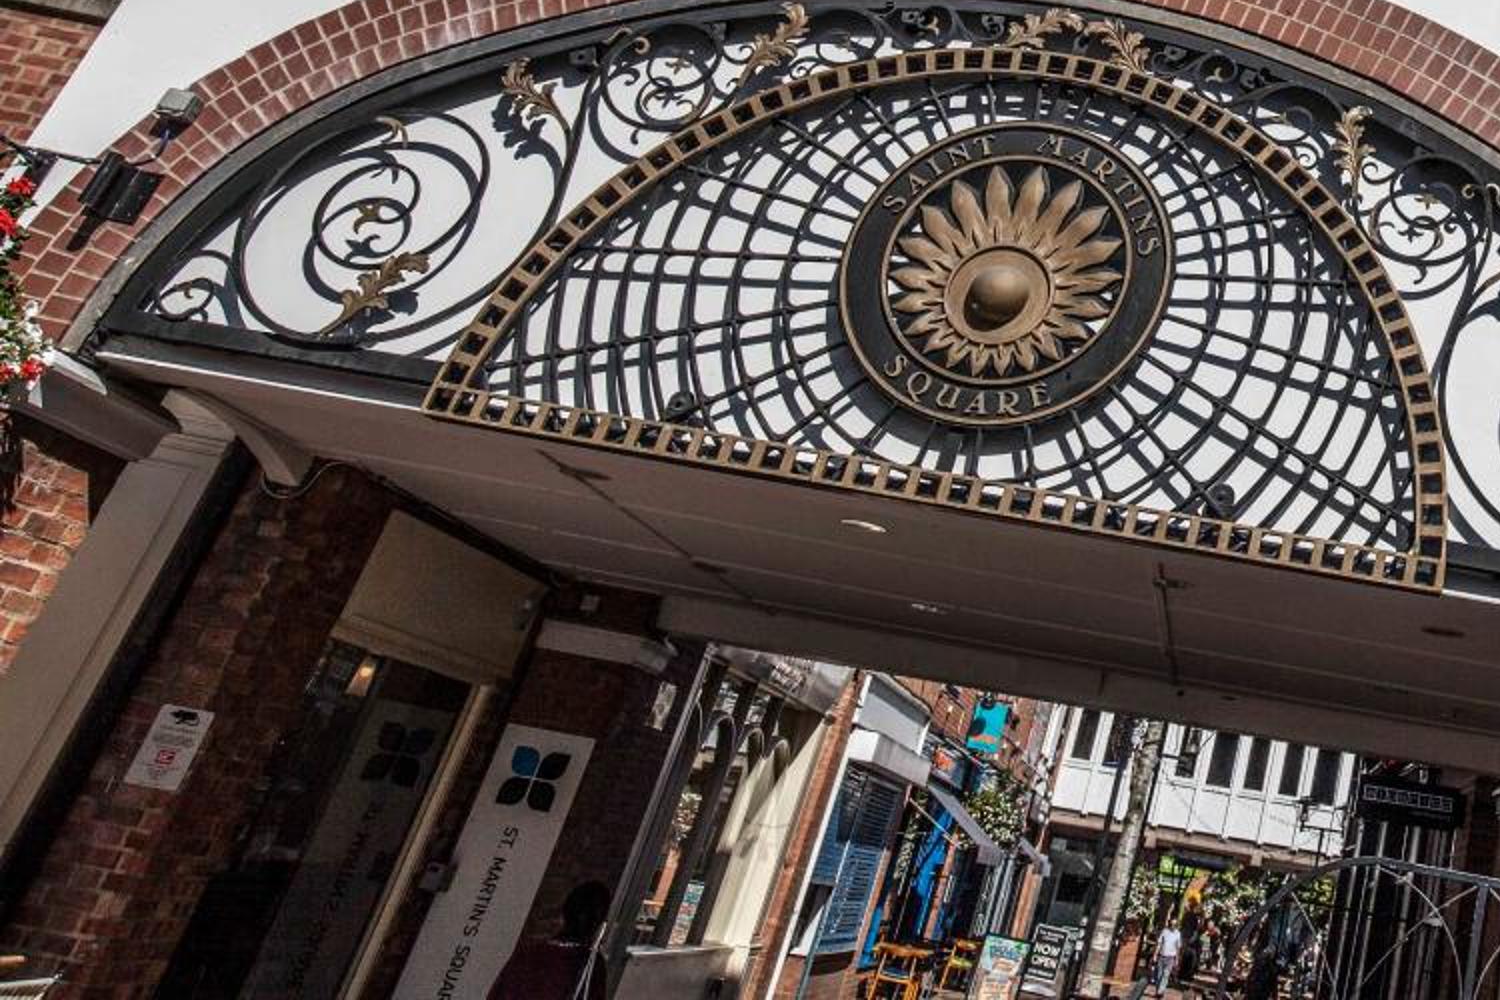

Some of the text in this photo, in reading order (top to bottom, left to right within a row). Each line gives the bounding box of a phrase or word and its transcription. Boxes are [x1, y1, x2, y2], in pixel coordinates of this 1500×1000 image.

[881, 132, 1162, 257] SAINT MARTINS
[882, 354, 1051, 415] SQUARE
[499, 826, 519, 850] ST.
[463, 856, 507, 938] MARTIN'S
[1031, 954, 1057, 969] OPEN
[1034, 941, 1060, 957] NOW
